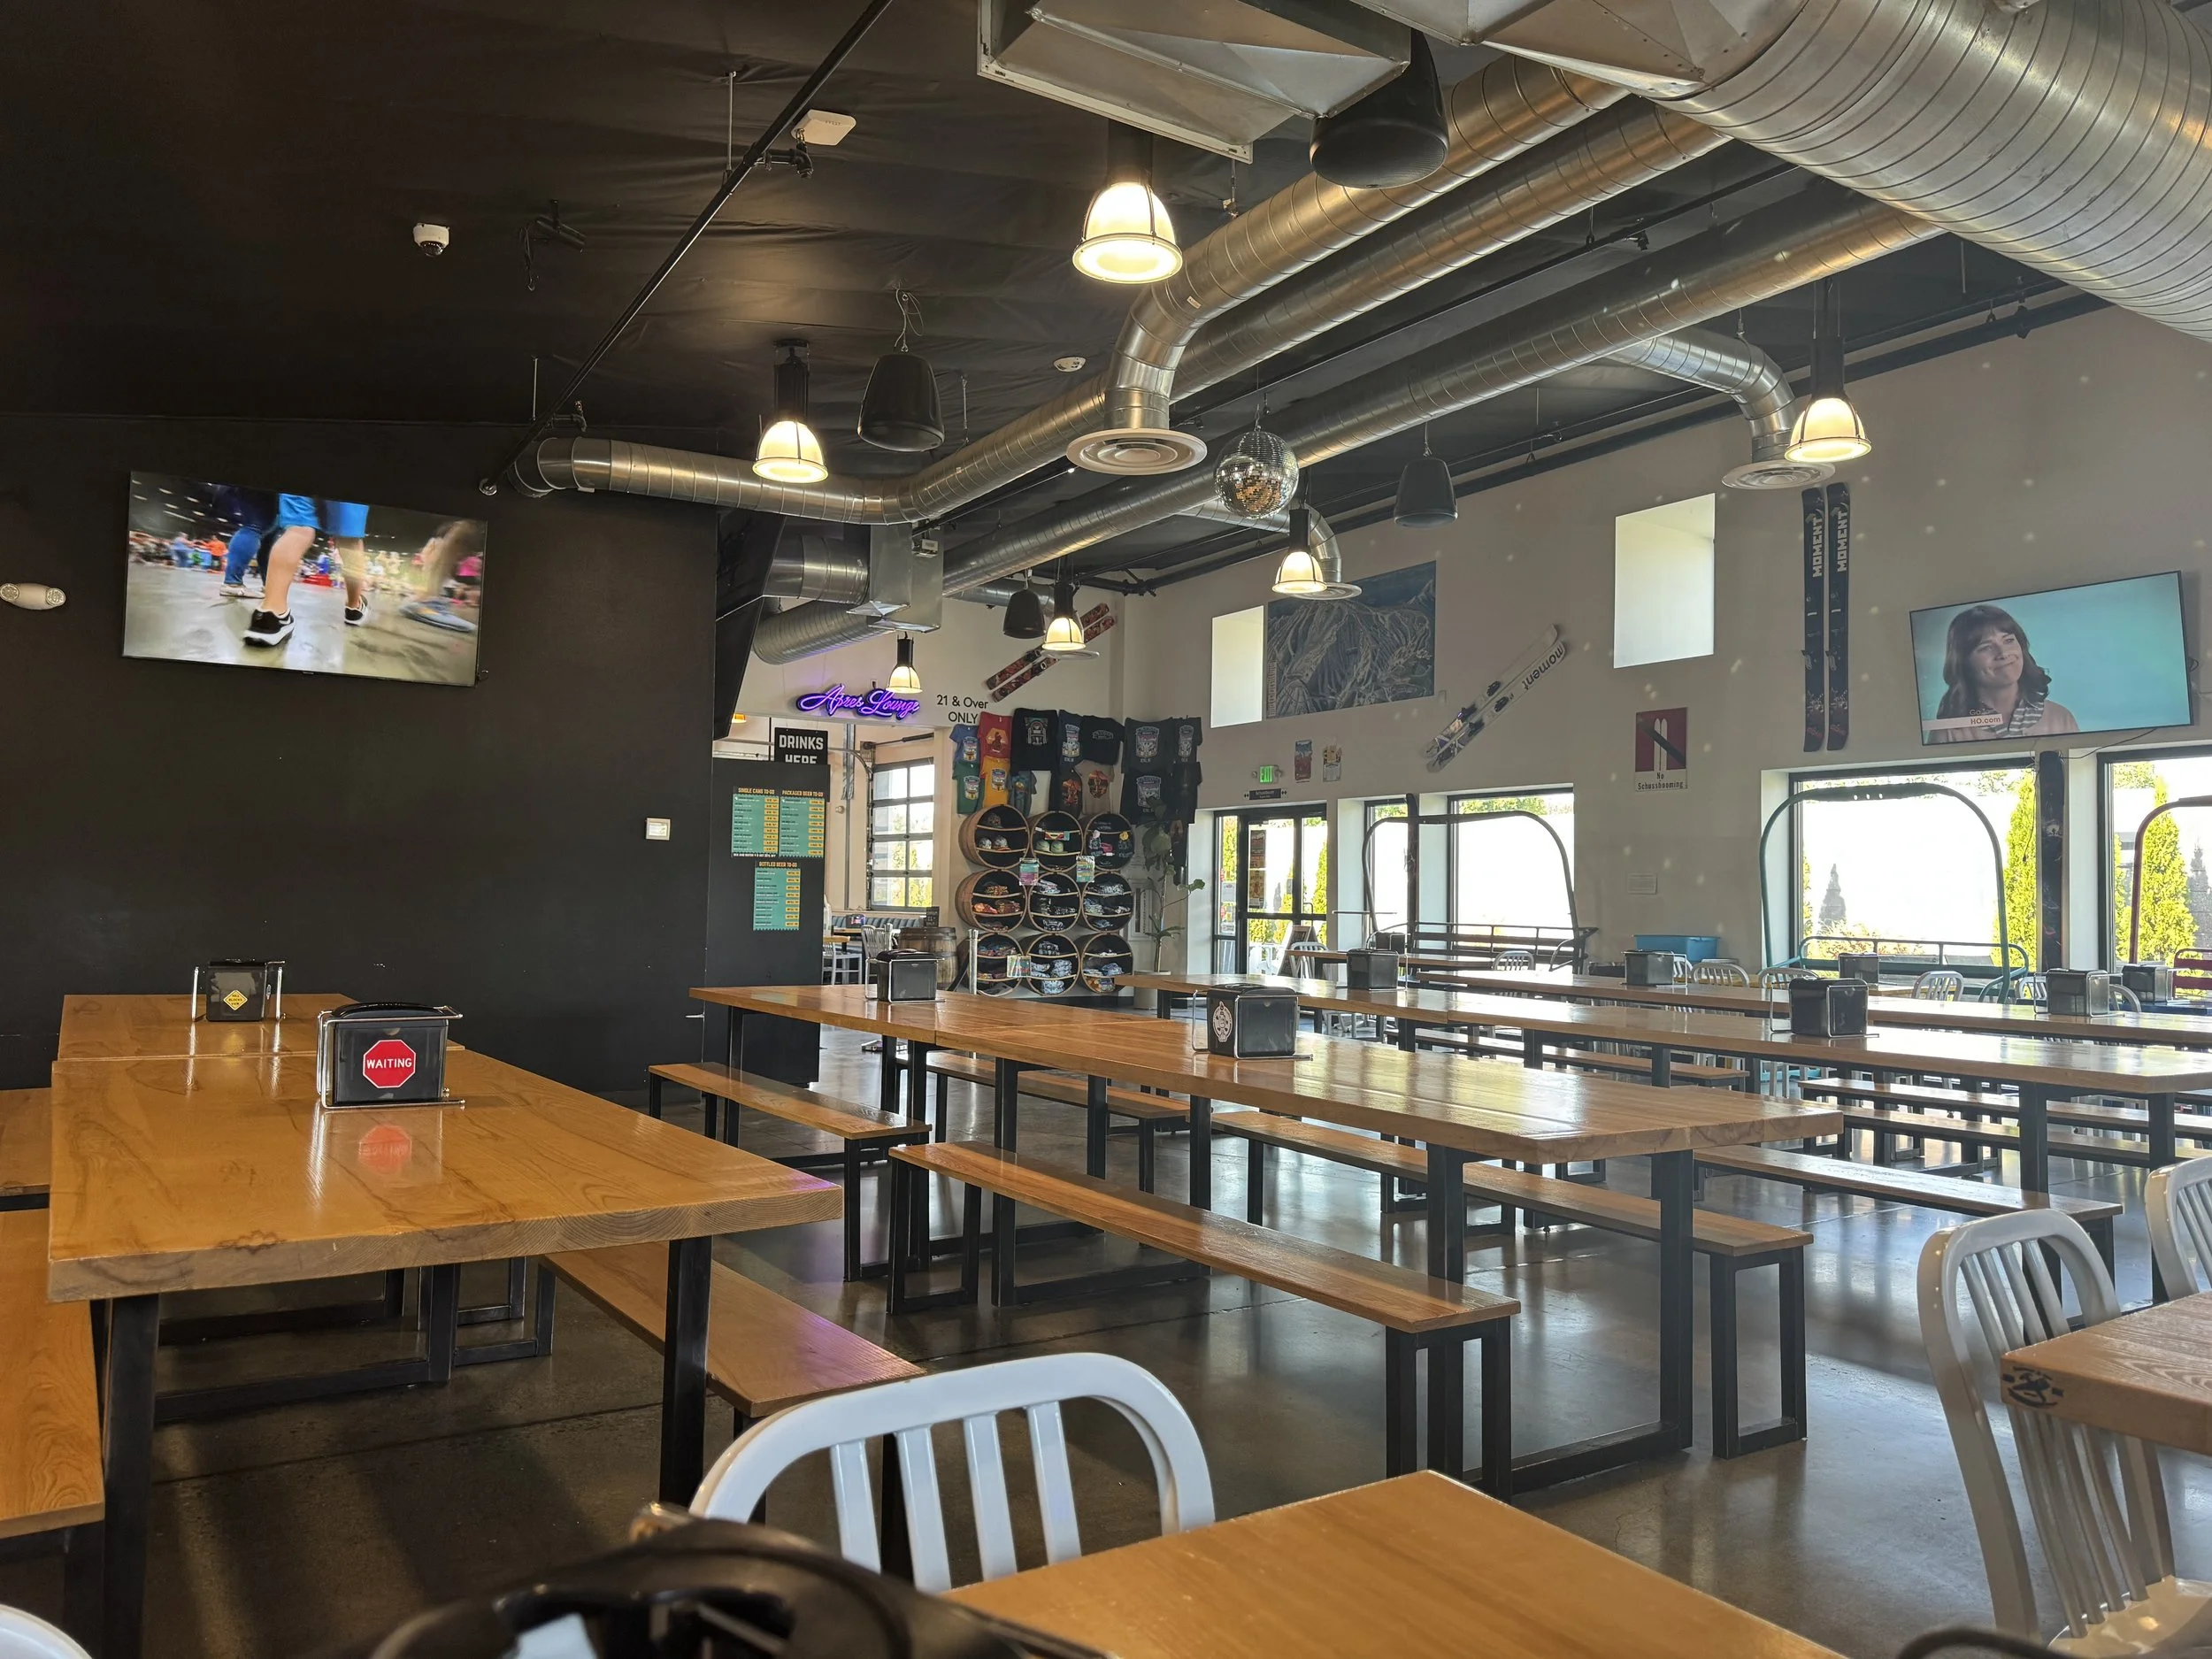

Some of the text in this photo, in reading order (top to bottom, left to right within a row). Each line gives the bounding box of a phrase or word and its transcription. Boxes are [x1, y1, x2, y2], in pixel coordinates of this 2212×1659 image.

[1812, 518, 1823, 577] MOMENT
[1837, 511, 1847, 572] MOMENT
[1522, 645, 1564, 690] moment
[859, 689, 920, 719] Lounge
[936, 694, 989, 709] 21 & Over
[948, 711, 979, 724] ONLY
[779, 734, 824, 750] DRINKS
[366, 1057, 412, 1069] WAITING
